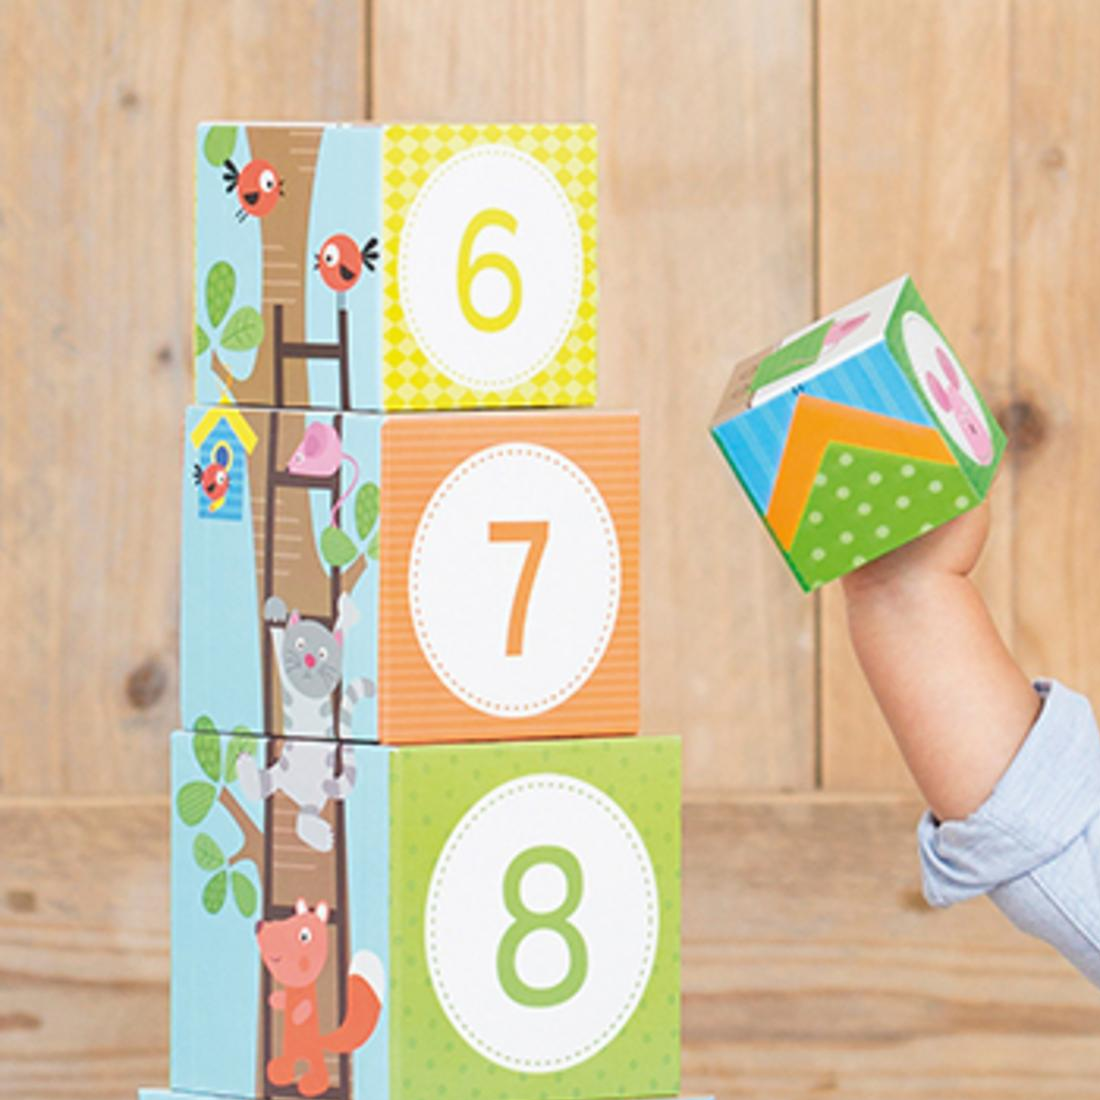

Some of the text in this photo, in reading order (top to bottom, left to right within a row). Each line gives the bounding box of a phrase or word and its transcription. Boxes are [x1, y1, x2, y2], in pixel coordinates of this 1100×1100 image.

[455, 208, 524, 334] 6
[487, 519, 551, 658] 7
[496, 844, 589, 1009] 8
